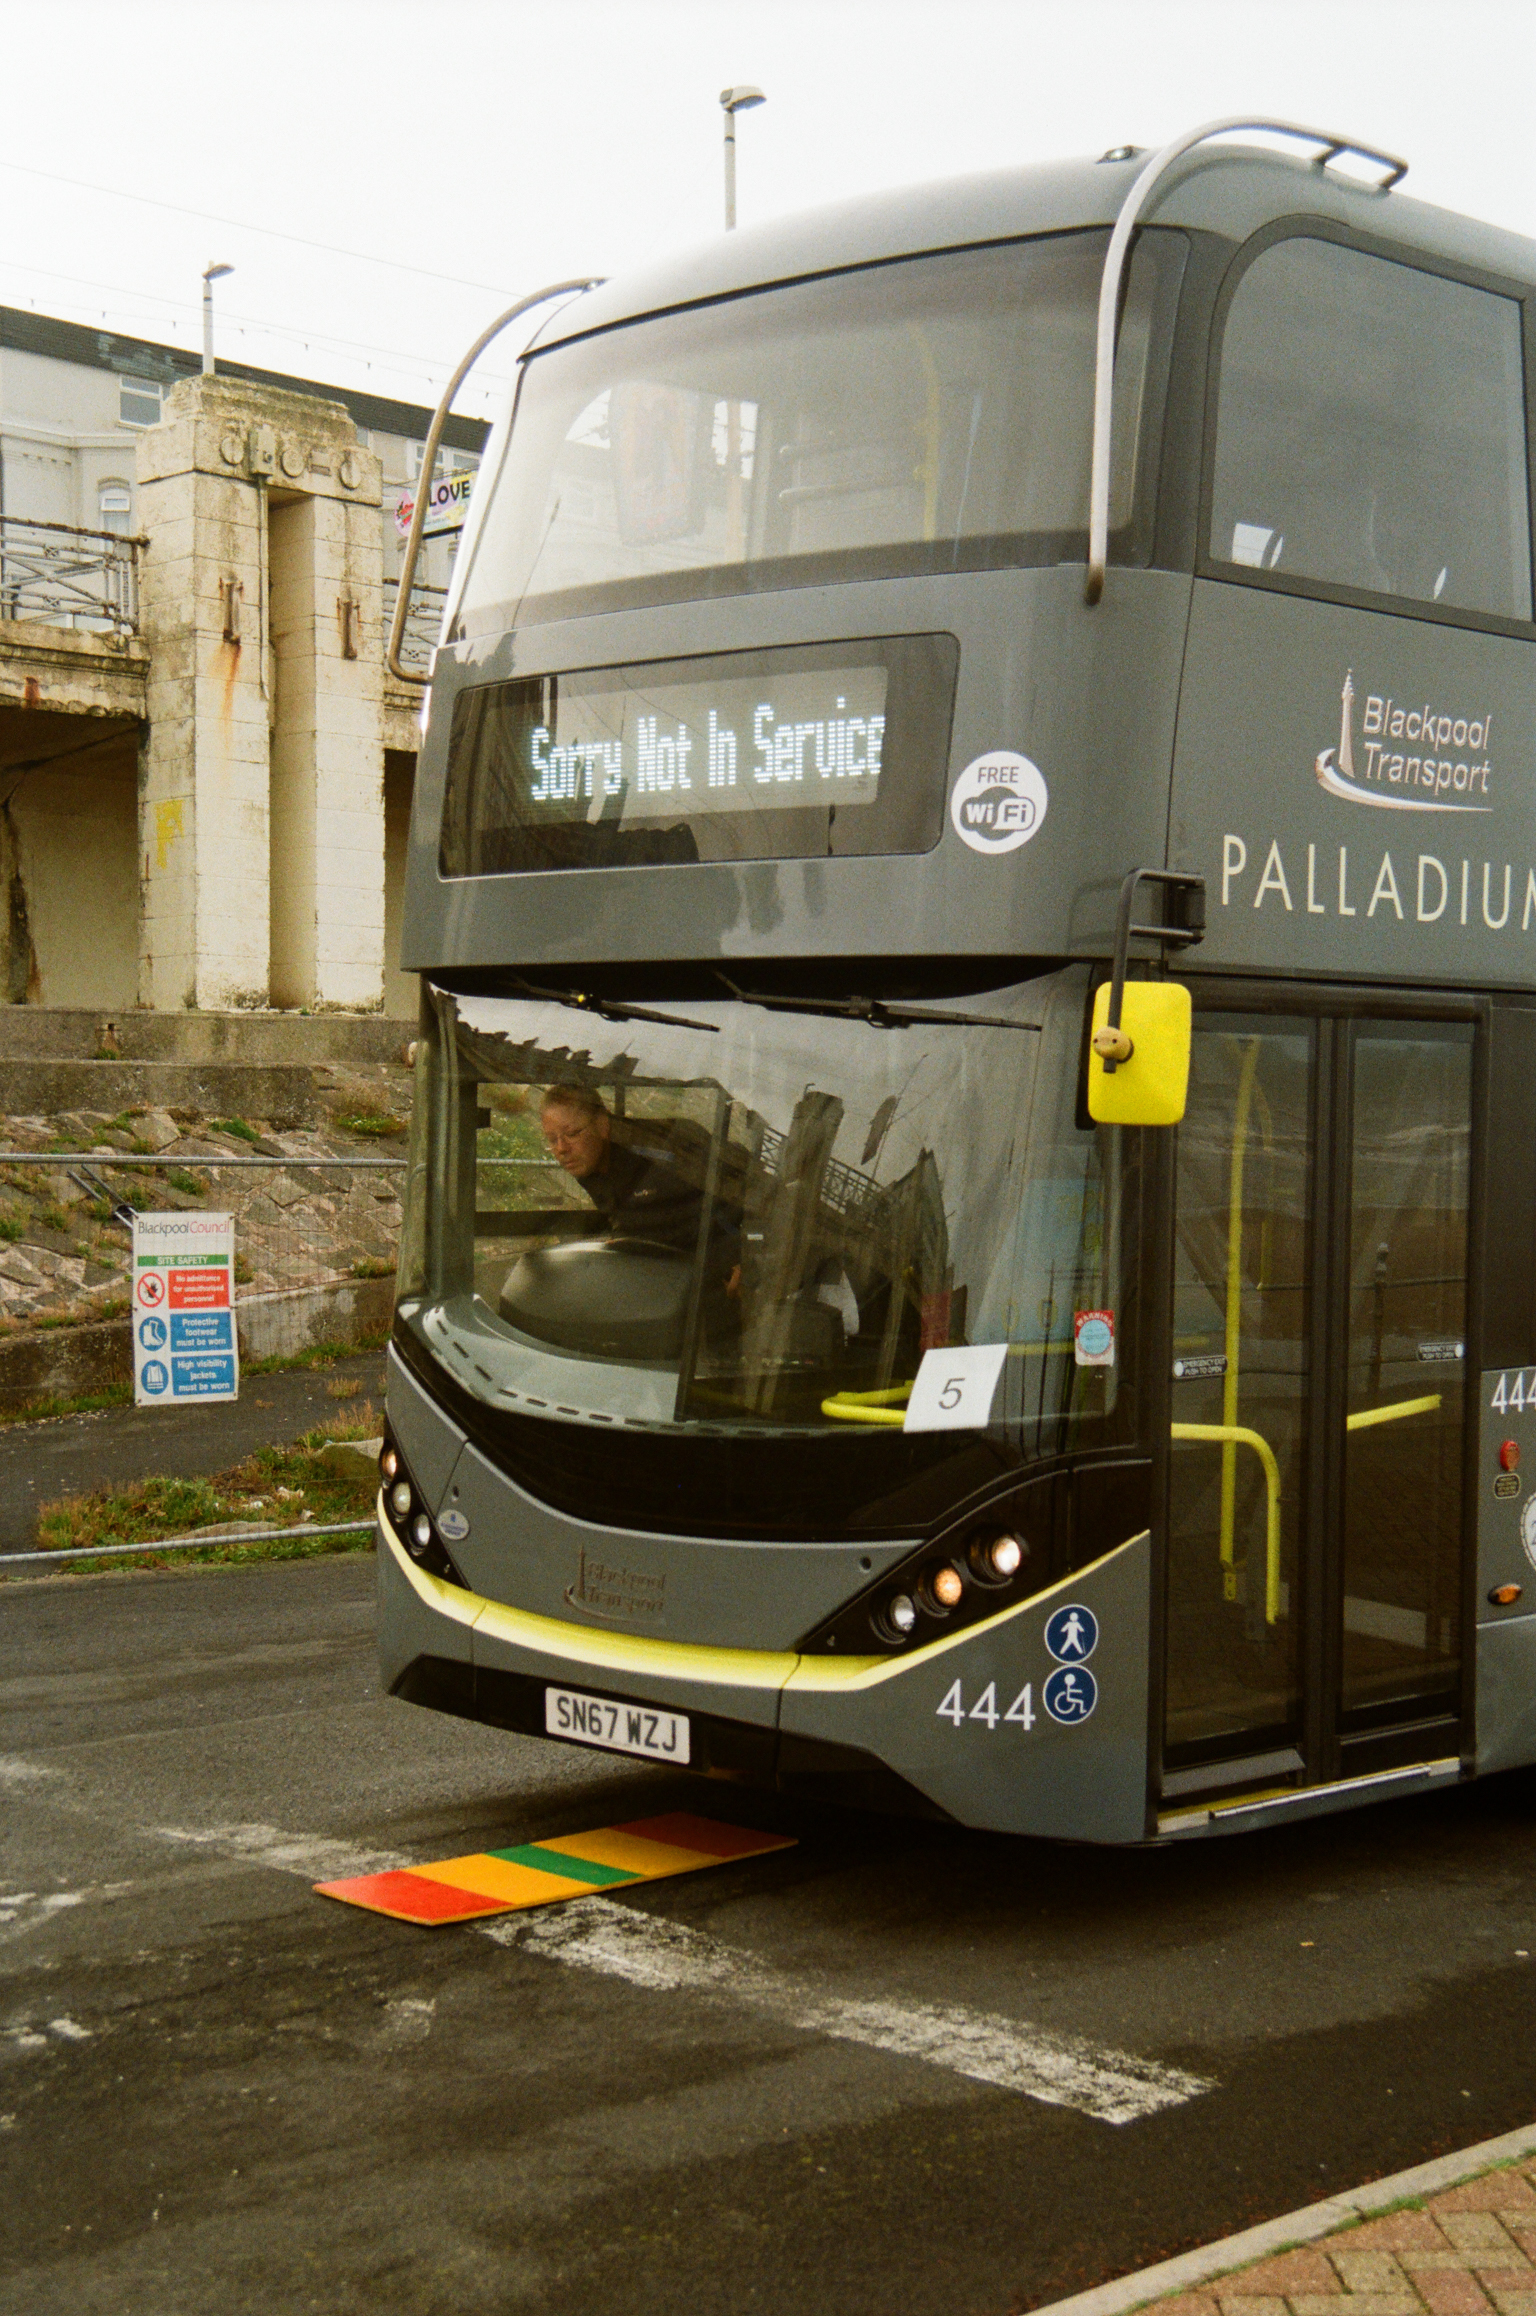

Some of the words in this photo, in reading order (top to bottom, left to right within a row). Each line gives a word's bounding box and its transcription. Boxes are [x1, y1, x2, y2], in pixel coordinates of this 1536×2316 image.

[429, 480, 470, 507] LOVE
[1363, 696, 1491, 751] Blackpool
[531, 727, 622, 800] Sorry
[637, 716, 692, 792] Not
[754, 696, 886, 783] Service
[977, 766, 1020, 784] FREE
[1364, 742, 1491, 795] Transport
[157, 1256, 175, 1265] SITE
[177, 1255, 208, 1265] SAFETY
[184, 1295, 214, 1303] personnel
[182, 1318, 219, 1327] Protective
[1076, 1312, 1113, 1327] WARNING
[185, 1328, 217, 1337] footwear
[176, 1339, 194, 1347] must
[208, 1338, 226, 1346] worn
[177, 1360, 194, 1371] High
[196, 1360, 228, 1369] visibility
[190, 1371, 217, 1382] jackets
[178, 1384, 197, 1393] must
[199, 1383, 209, 1391] be
[211, 1382, 230, 1390] worn
[938, 1377, 966, 1410] 5
[936, 1678, 1036, 1731] 444
[557, 1695, 618, 1739] SN67
[627, 1710, 676, 1752] WZJ
